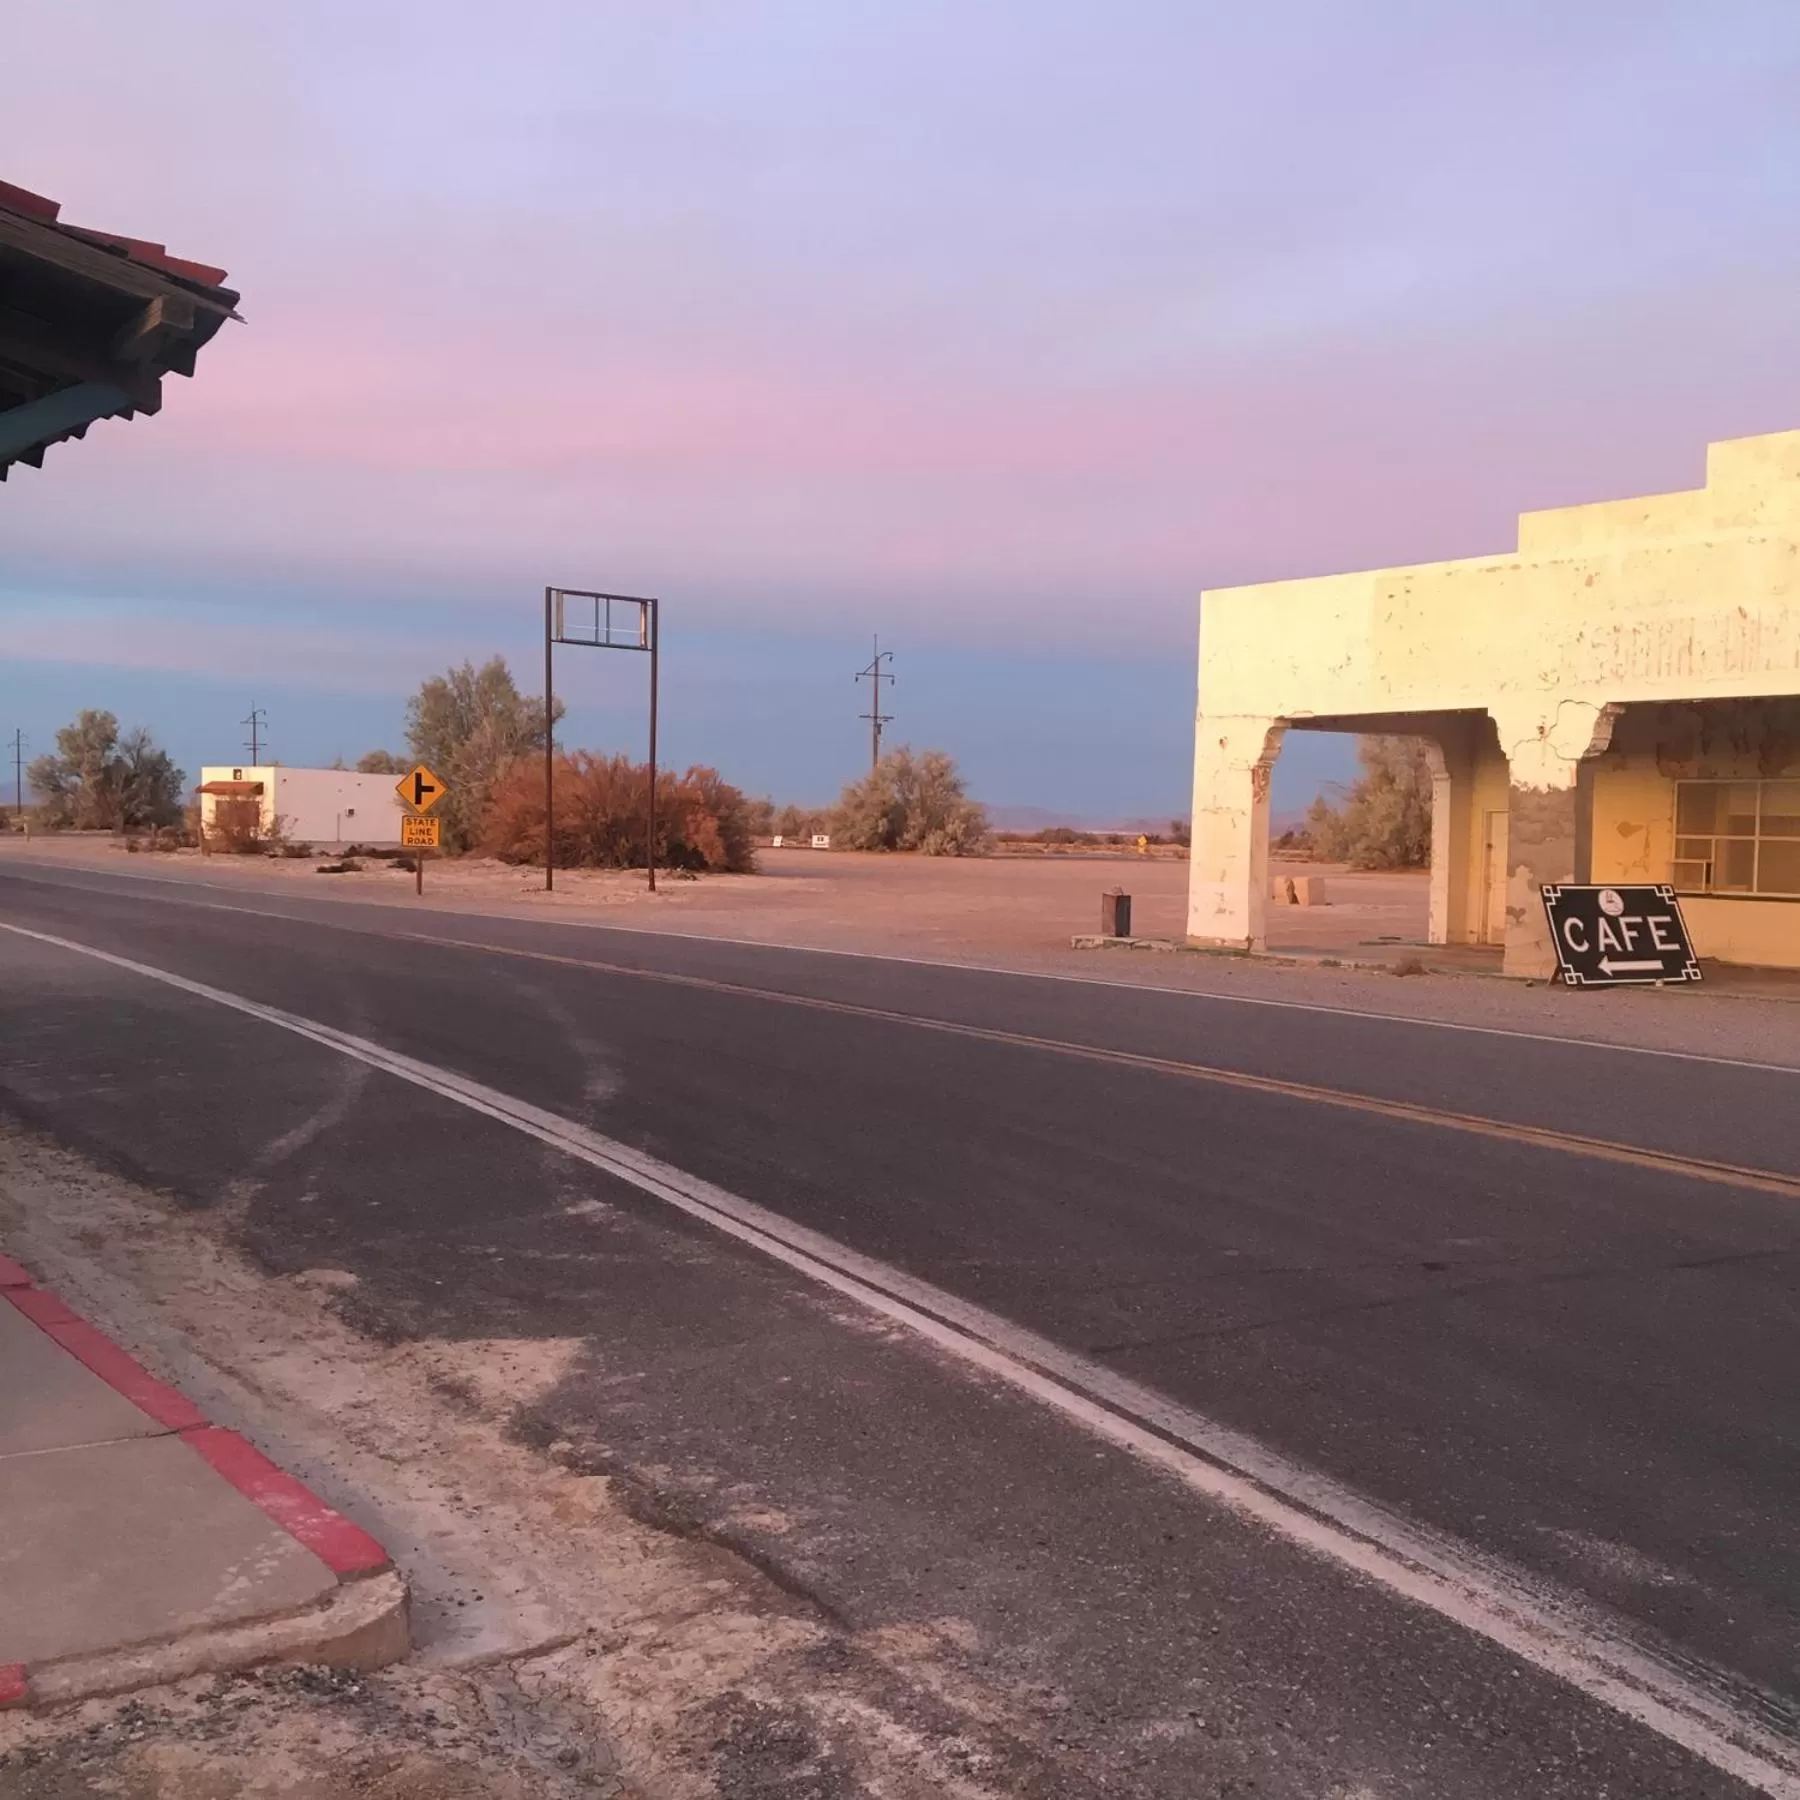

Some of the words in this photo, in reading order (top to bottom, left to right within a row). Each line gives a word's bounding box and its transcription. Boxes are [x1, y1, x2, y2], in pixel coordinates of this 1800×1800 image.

[406, 817, 436, 826] STATE
[409, 827, 432, 836] LINE
[407, 837, 434, 845] ROAD
[1563, 915, 1681, 953] CAFE
